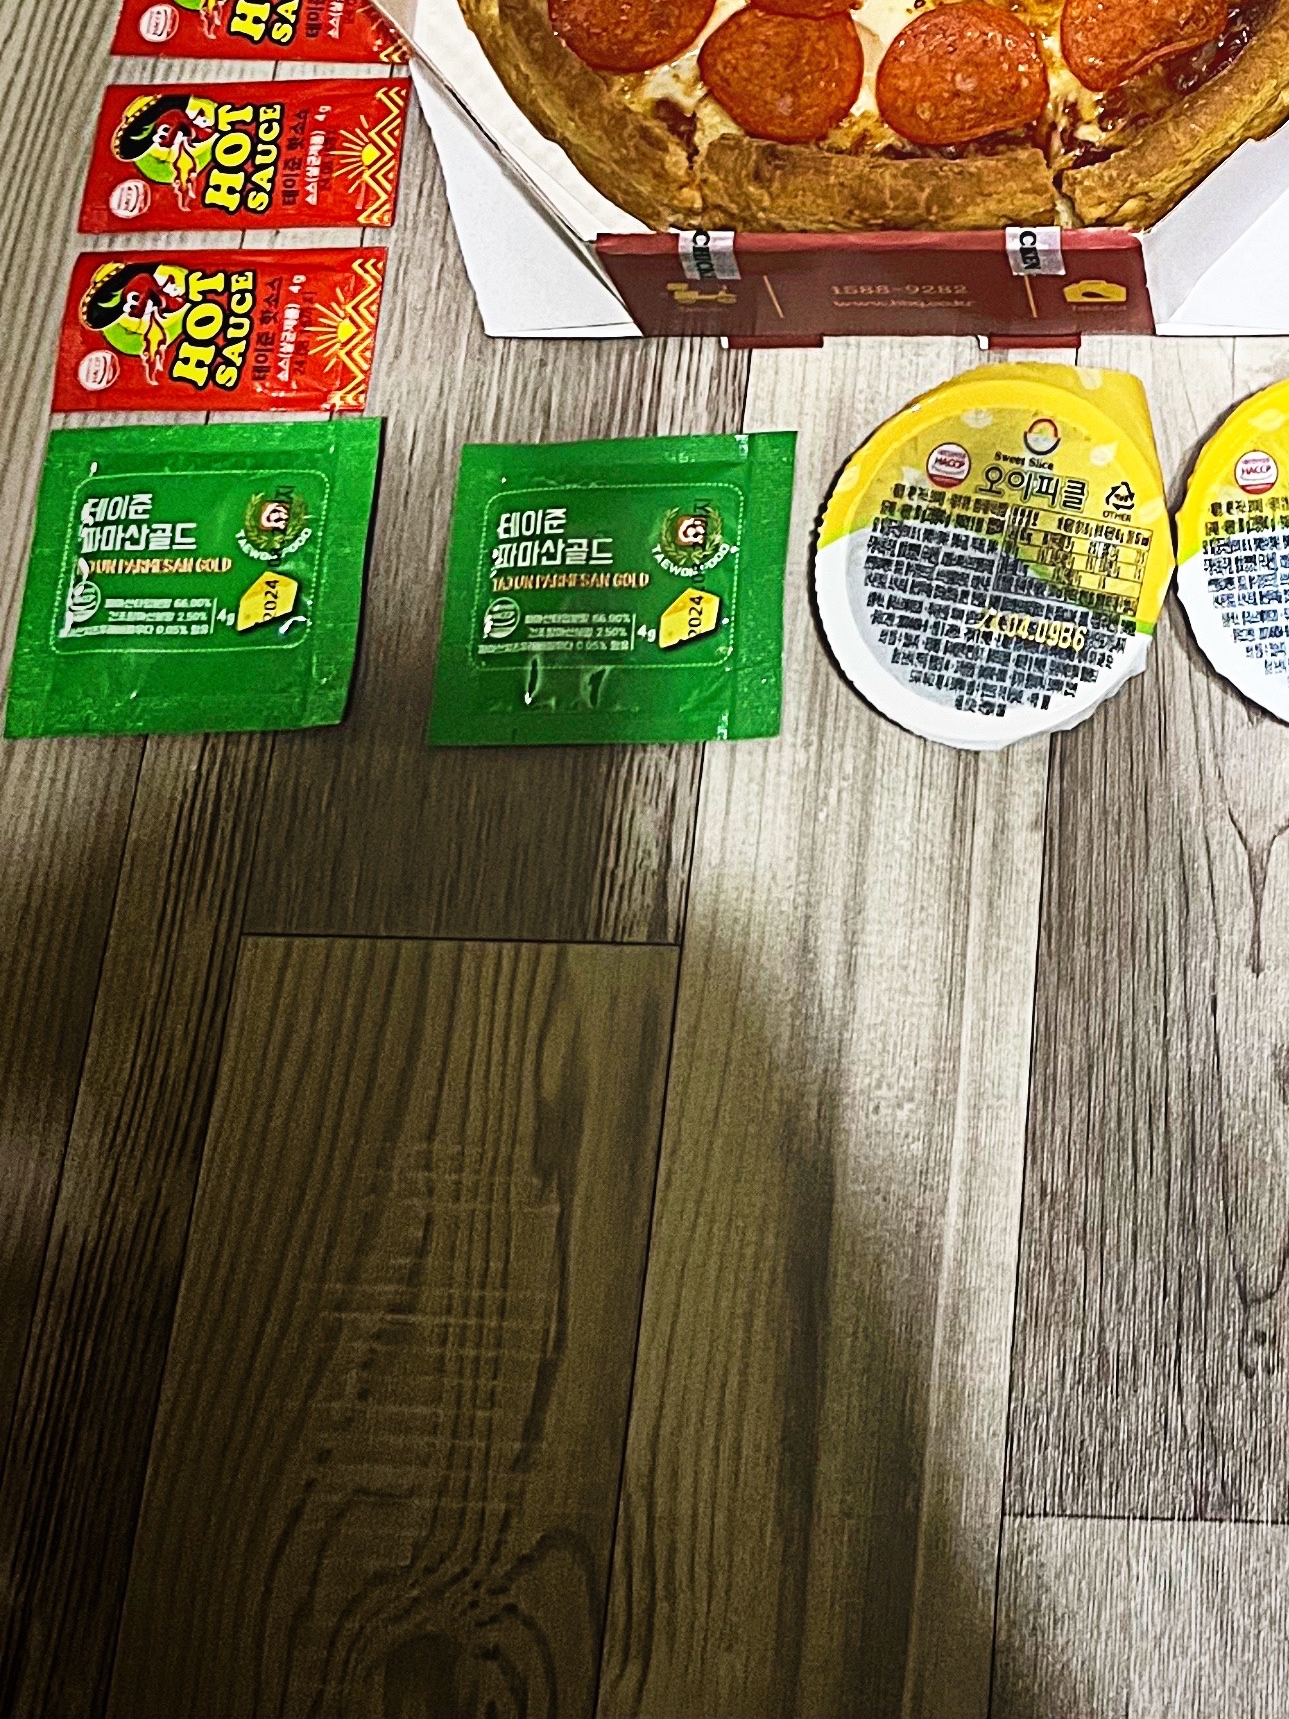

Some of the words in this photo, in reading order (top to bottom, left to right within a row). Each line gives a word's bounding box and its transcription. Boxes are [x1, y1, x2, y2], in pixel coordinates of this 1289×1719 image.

[314, 104, 331, 121] 4g
[206, 104, 255, 209] HOT
[248, 105, 281, 210] SAUCE
[288, 274, 307, 294] 4g
[174, 272, 226, 385] HOT
[216, 272, 253, 386] SAUCE
[995, 451, 1025, 467] Sweet
[1029, 457, 1054, 470] Slice
[1241, 465, 1271, 475] HACCP
[976, 466, 1088, 511] 오이피클
[497, 509, 566, 539] 테이준
[1103, 511, 1131, 523] OTHER
[81, 523, 197, 553] 파마산골드
[497, 539, 613, 567] 파마산골드
[196, 559, 232, 572] GOLD
[612, 573, 649, 587] GOLD
[216, 610, 235, 626] 4g
[688, 595, 704, 637] 2024
[638, 625, 656, 641] 4g
